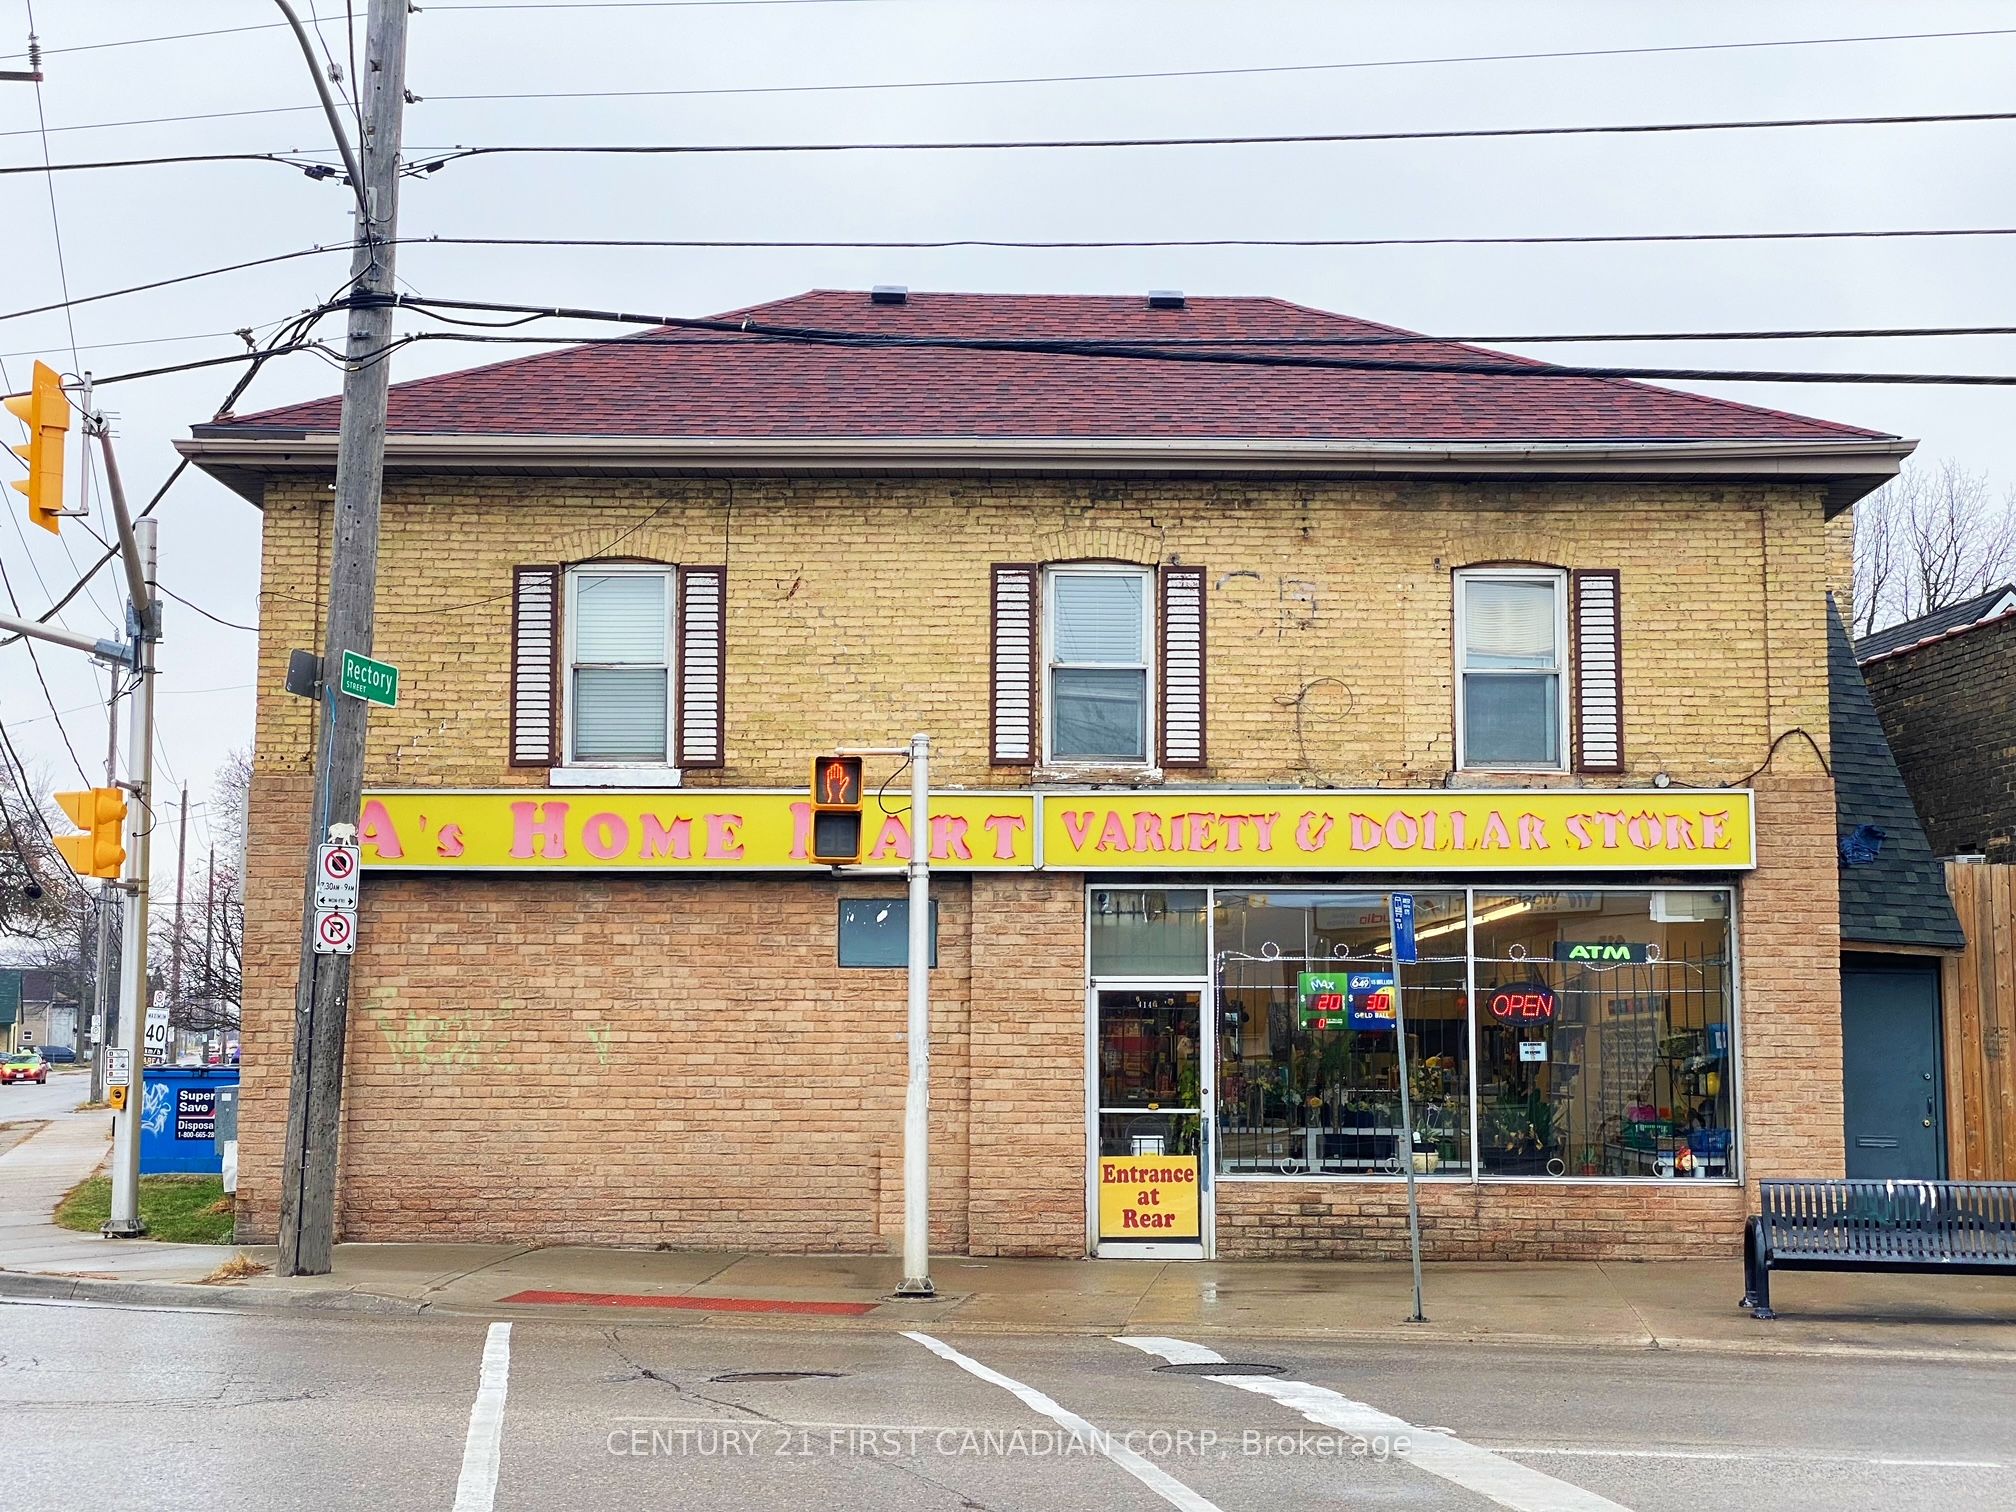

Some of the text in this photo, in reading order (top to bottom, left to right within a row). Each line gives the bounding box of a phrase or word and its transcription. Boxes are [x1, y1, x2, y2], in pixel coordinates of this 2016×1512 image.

[347, 659, 392, 694] Rectory
[346, 681, 366, 692] STREET
[508, 801, 744, 860] HOME
[1061, 809, 1731, 853] VARIETY & DOLLAR STORE
[1569, 945, 1631, 960] ATM
[1310, 979, 1335, 991] MAX
[1318, 995, 1340, 1010] 20
[1366, 995, 1388, 1010] 30
[1493, 995, 1552, 1017] OPEN
[146, 1024, 165, 1042] 40
[144, 1047, 161, 1056] km/h
[180, 1090, 215, 1102] Super
[179, 1102, 209, 1112] Save
[178, 1120, 214, 1131] Disposa
[1102, 1164, 1194, 1183] Entrance
[1137, 1188, 1160, 1206] at
[1122, 1208, 1176, 1228] Rear
